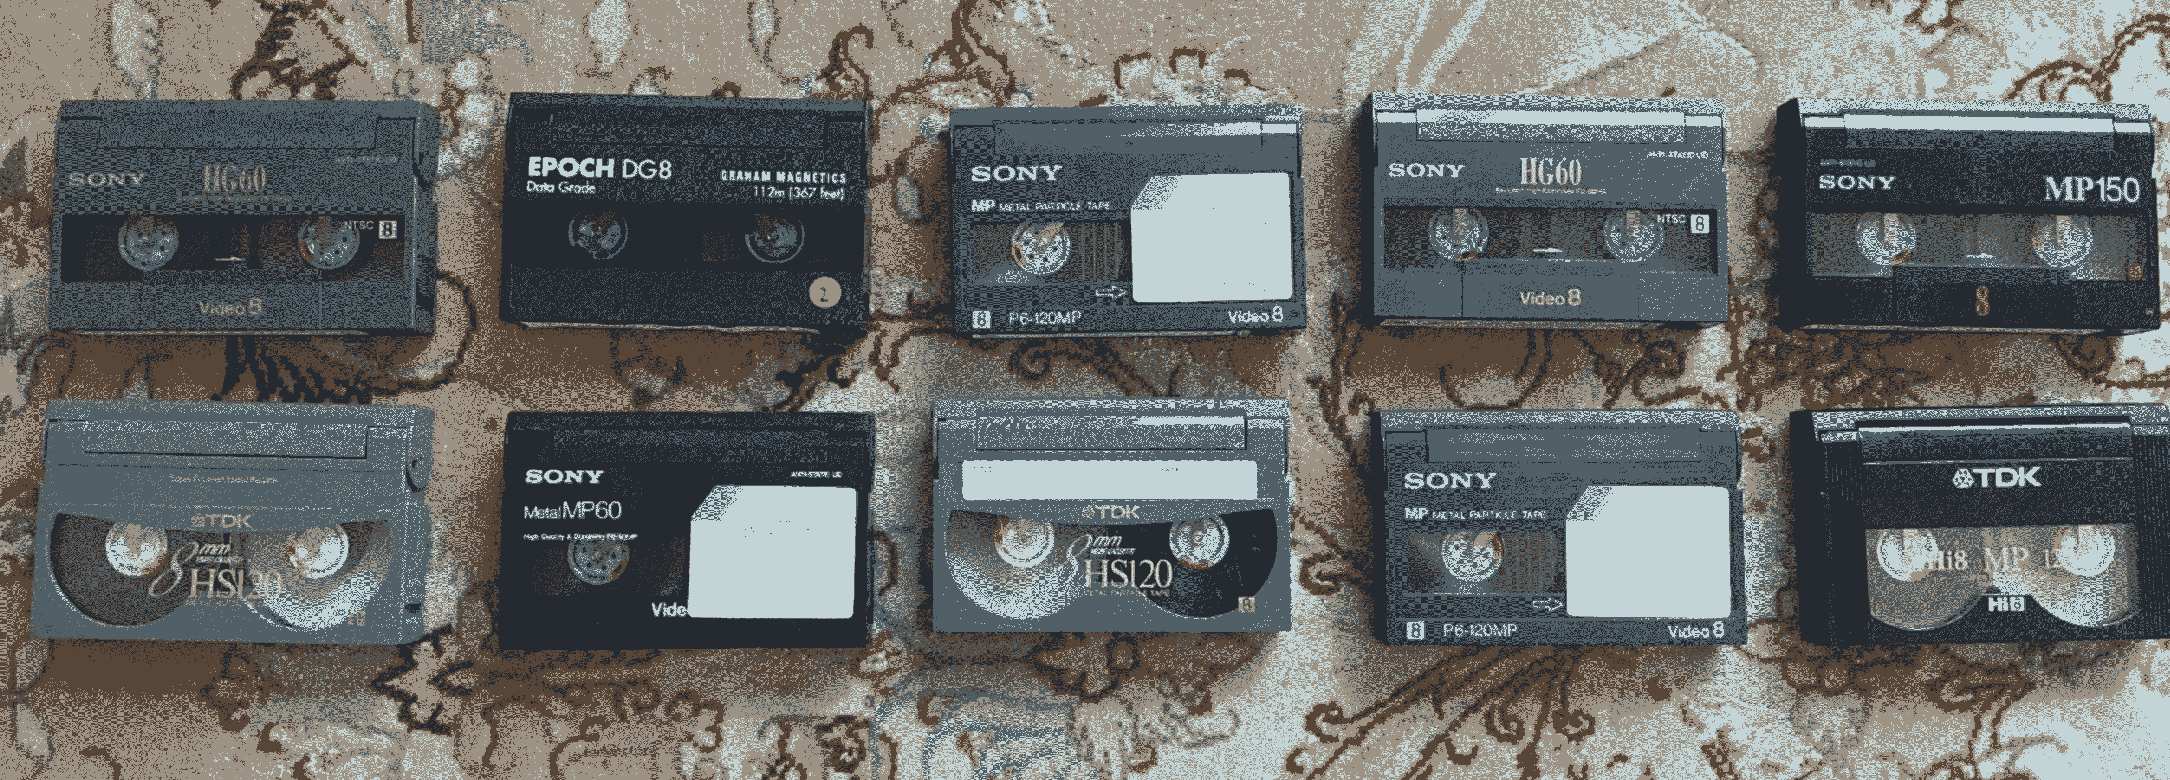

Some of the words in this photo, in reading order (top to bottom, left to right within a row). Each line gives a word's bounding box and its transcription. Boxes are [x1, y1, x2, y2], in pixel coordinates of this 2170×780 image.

[528, 156, 614, 179] EPOCH
[622, 158, 672, 180] DG8
[720, 169, 772, 182] GRAHAM
[776, 171, 847, 184] MAGNETICS
[971, 164, 1063, 182] SONY
[1388, 162, 1466, 178] SONY
[1520, 157, 1582, 186] HG60
[68, 172, 145, 187] SONY
[203, 163, 268, 193] HG60
[1819, 174, 1896, 190] SONY
[526, 180, 555, 193] Data
[558, 180, 597, 194] Grade
[753, 186, 785, 198] 112m
[2045, 176, 2140, 202] MP150
[971, 199, 996, 212] MP
[344, 220, 374, 232] NTSC
[1656, 214, 1686, 224] NTSC
[820, 286, 829, 303] 2
[1974, 286, 1991, 316] 8
[1008, 309, 1082, 326] P6-120MP
[525, 468, 604, 485] SONY
[1404, 472, 1497, 490] SONY
[1972, 465, 2042, 488] TDK
[1095, 504, 1141, 519] TDK
[1404, 507, 1428, 519] MP
[205, 513, 254, 530] TDK
[1084, 558, 1174, 588] HS120
[189, 567, 284, 599] HS120
[1988, 596, 2026, 612] Hi8
[1443, 622, 1518, 638] P6-120MP
